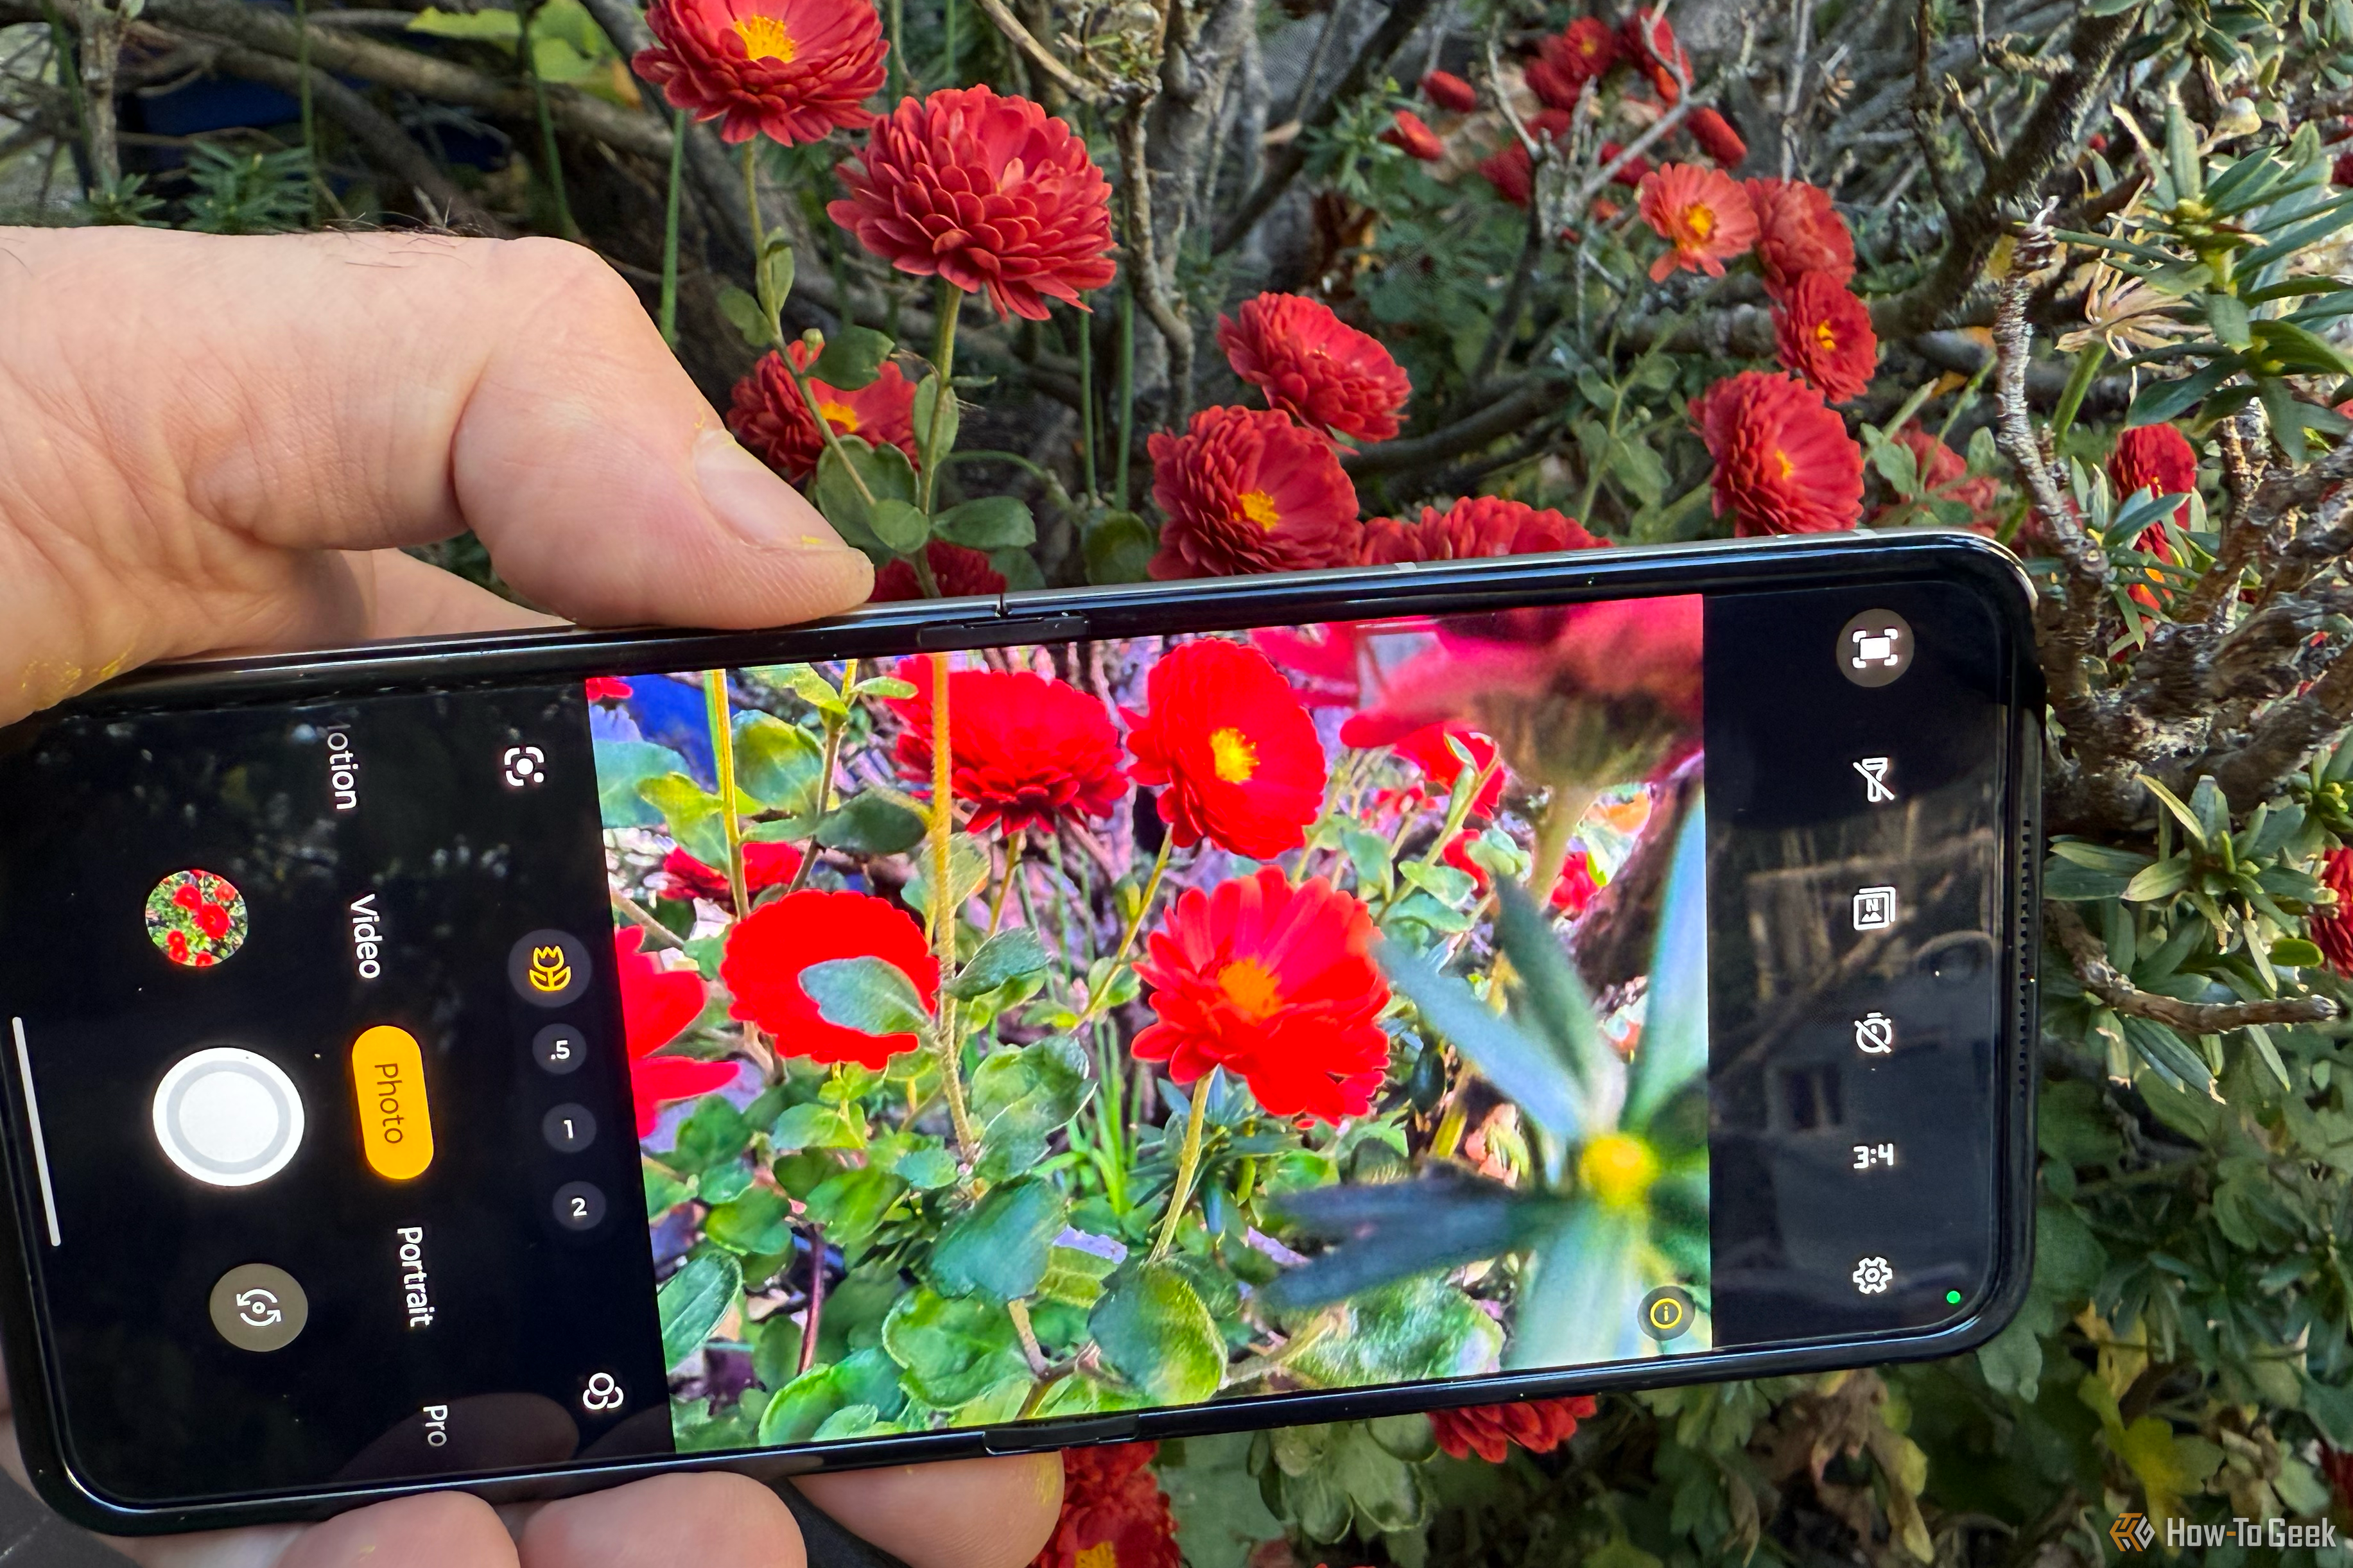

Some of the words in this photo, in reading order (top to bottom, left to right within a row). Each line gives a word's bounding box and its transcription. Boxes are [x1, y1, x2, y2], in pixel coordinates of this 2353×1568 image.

[351, 893, 383, 979] Video
[550, 1040, 570, 1060] .5
[374, 1063, 404, 1144] Photo
[564, 1119, 573, 1139] 1
[1854, 1143, 1894, 1169] 3:4
[571, 1197, 587, 1216] 2
[397, 1227, 435, 1327] Portrait
[423, 1405, 448, 1447] Pro
